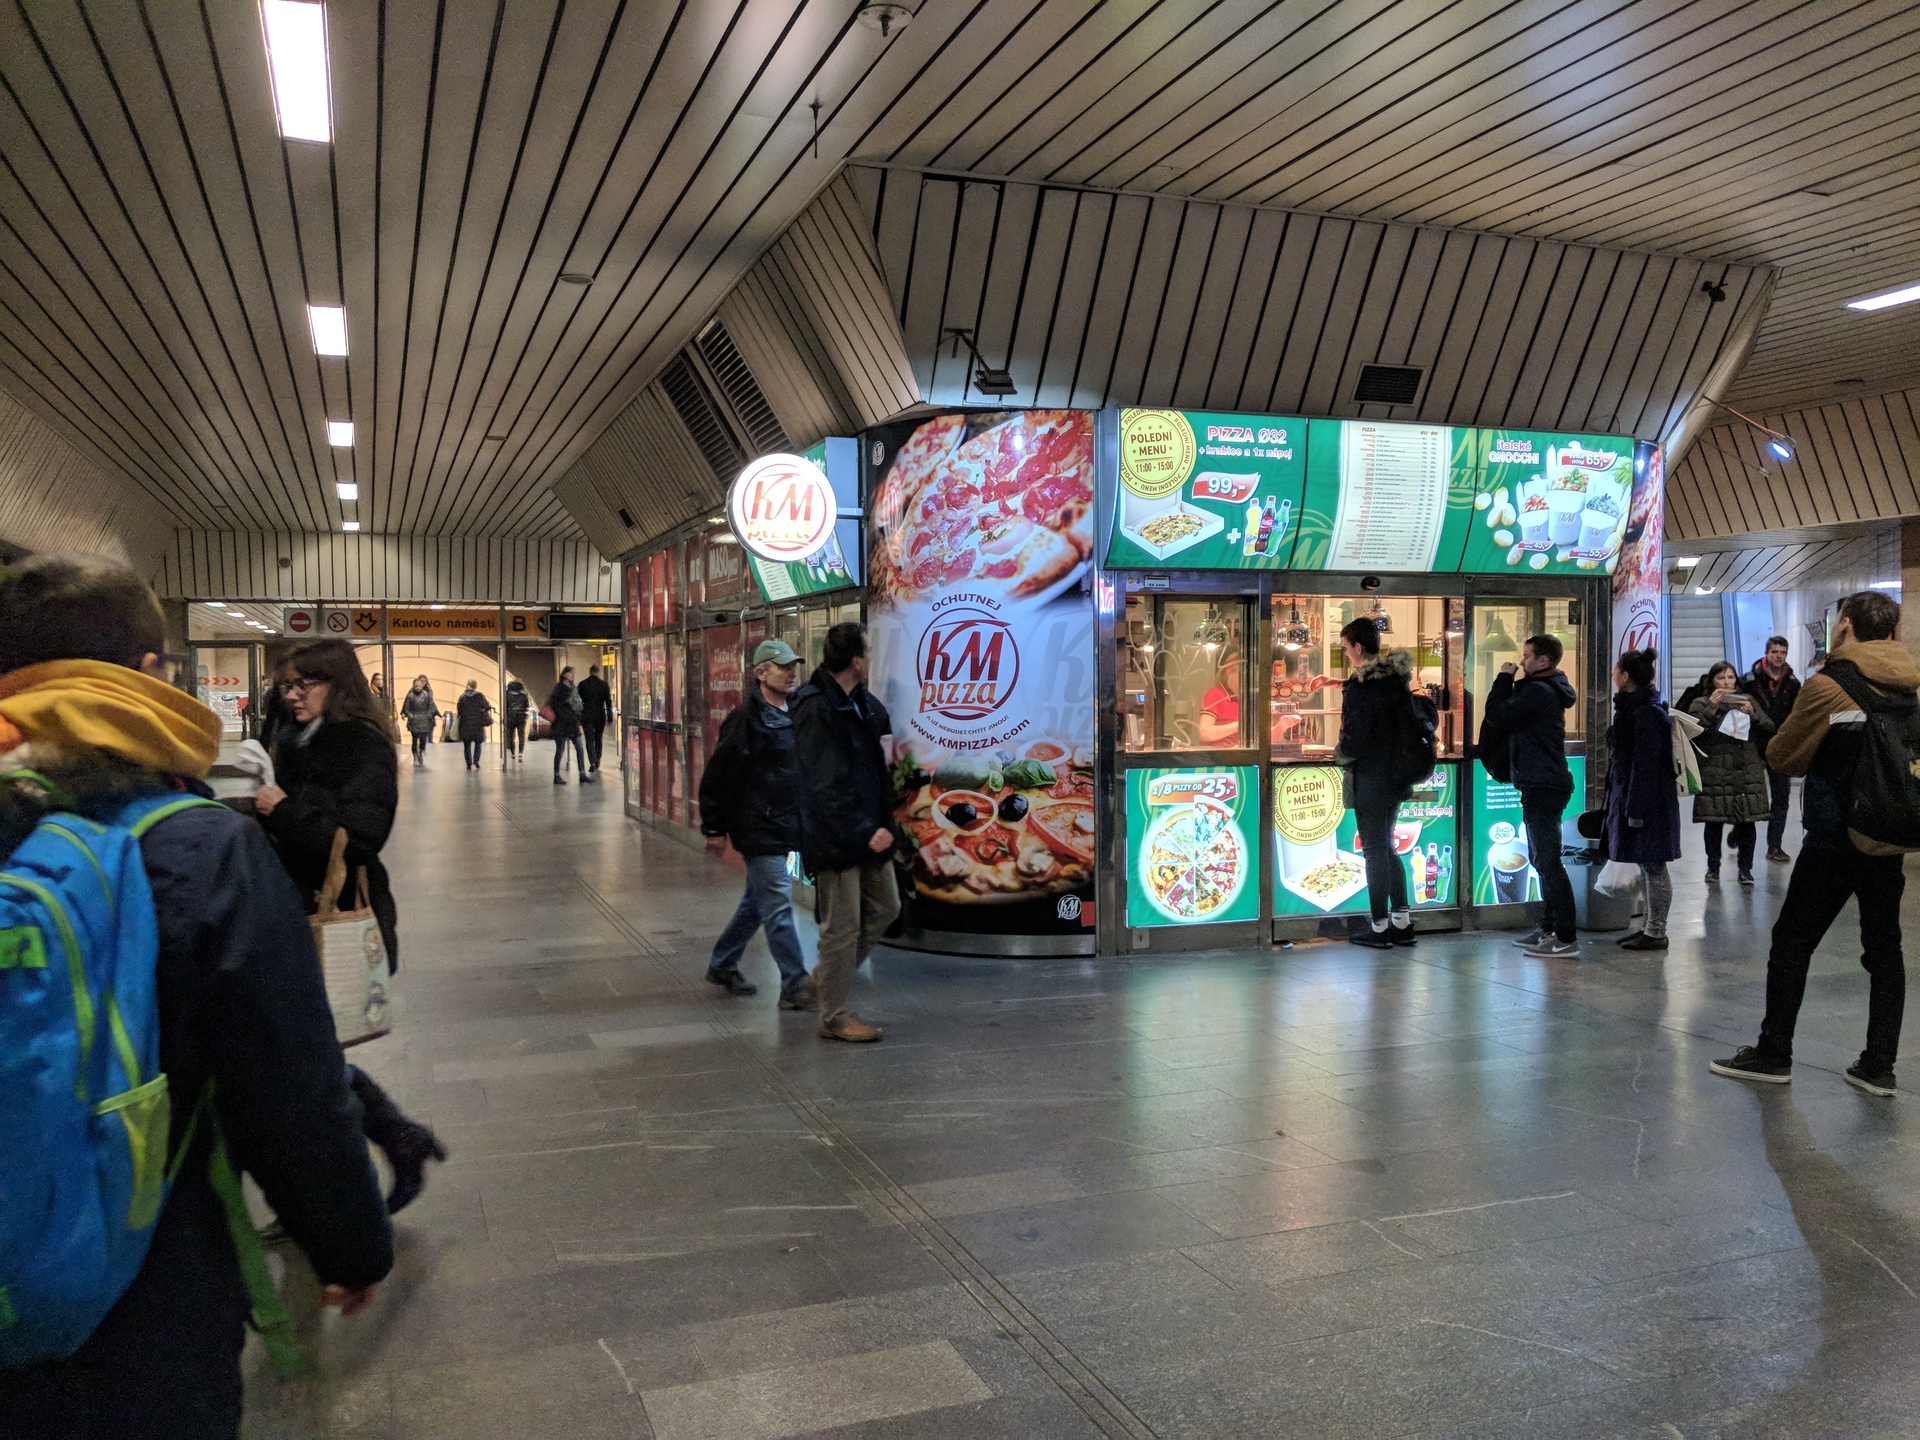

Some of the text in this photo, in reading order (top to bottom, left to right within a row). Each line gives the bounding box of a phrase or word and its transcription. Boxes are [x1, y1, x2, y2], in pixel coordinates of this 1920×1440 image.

[1130, 429, 1172, 444] POLEDNÍ
[1207, 426, 1255, 443] PIZZA
[1139, 445, 1167, 456] MENU
[1206, 445, 1242, 456] krabice
[1244, 448, 1250, 456] a
[1253, 447, 1264, 457] 1x
[1266, 448, 1292, 460] nápoj
[1497, 439, 1532, 451] italské
[1488, 452, 1539, 464] GNOCCHI
[1586, 455, 1607, 468] 65,-
[1136, 463, 1152, 473] 11:00
[1158, 461, 1173, 471] 15:00
[1208, 476, 1246, 498] 99,-
[750, 474, 814, 521] KM
[1589, 549, 1606, 558] 55,-
[932, 593, 1002, 612] OCHUTNEJ
[393, 616, 495, 629] Karlovo náměstí
[512, 616, 526, 632] B
[924, 620, 1010, 681] KM
[919, 681, 997, 713] pizza
[988, 715, 1009, 731] JINOU!
[910, 718, 1030, 750] www.KMPIZZA.com
[1152, 782, 1172, 798] 1/8
[1202, 778, 1234, 798] 25,-
[1286, 778, 1325, 795] POLEDNÍ
[1294, 794, 1320, 805] MENU
[1291, 812, 1306, 821] 11:00
[1311, 808, 1326, 818] 15:00
[1402, 805, 1453, 818] a 1x nápoj
[1060, 897, 1079, 911] KM
